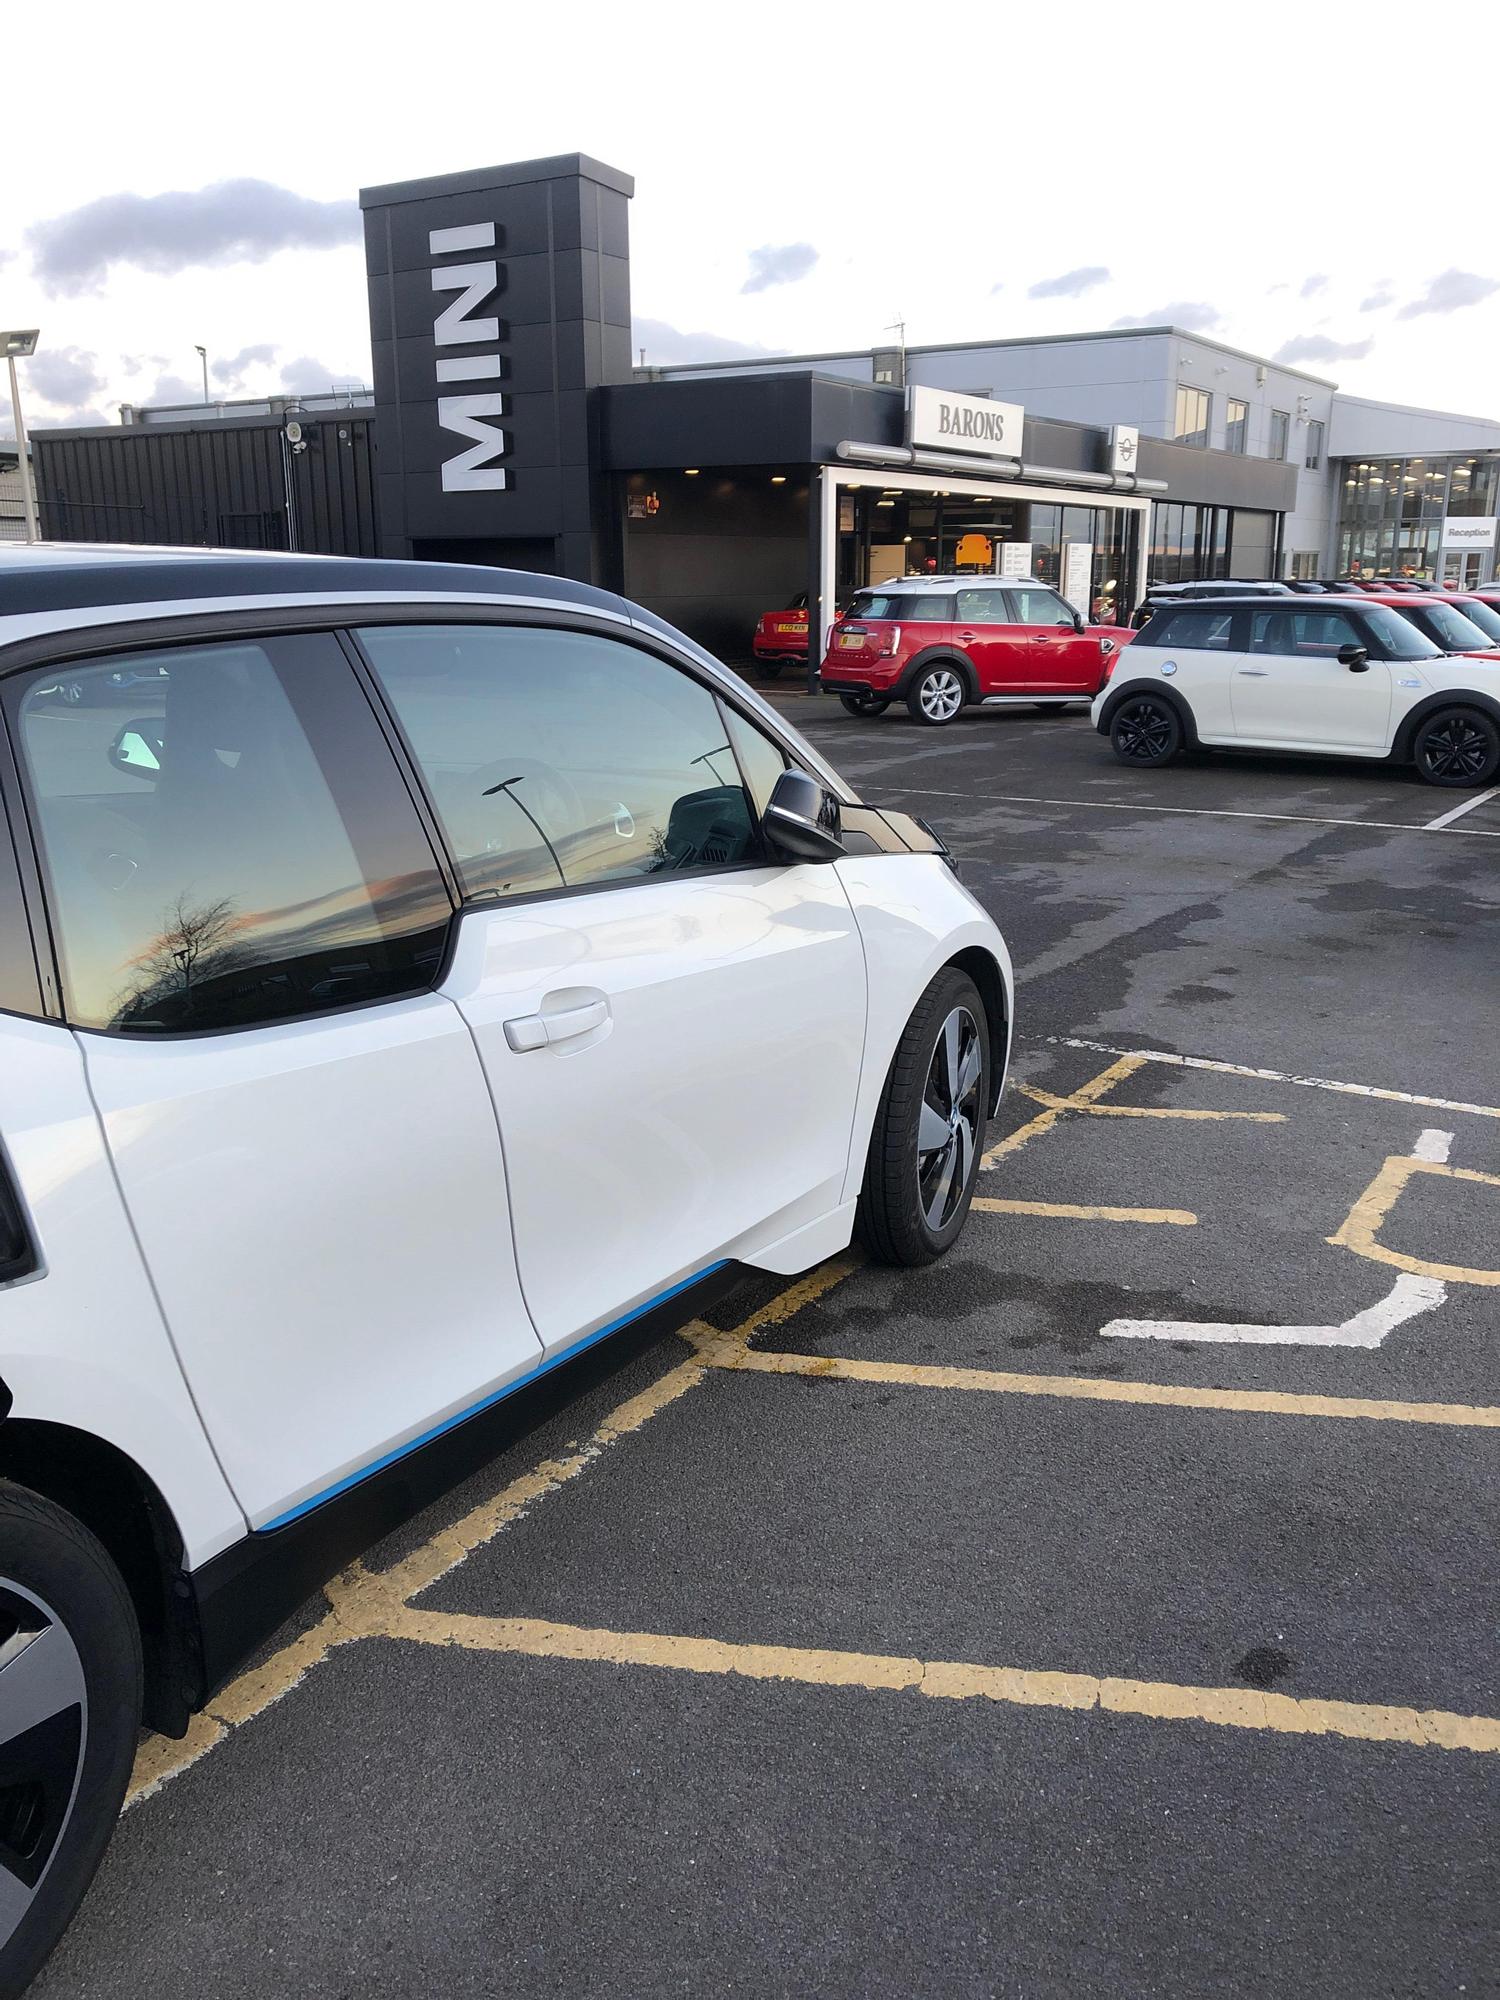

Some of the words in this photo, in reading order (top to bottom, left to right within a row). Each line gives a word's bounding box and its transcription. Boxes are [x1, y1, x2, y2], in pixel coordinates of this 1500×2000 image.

[429, 221, 506, 493] MINI
[938, 403, 1004, 442] BARONS
[1448, 527, 1491, 538] Reception
